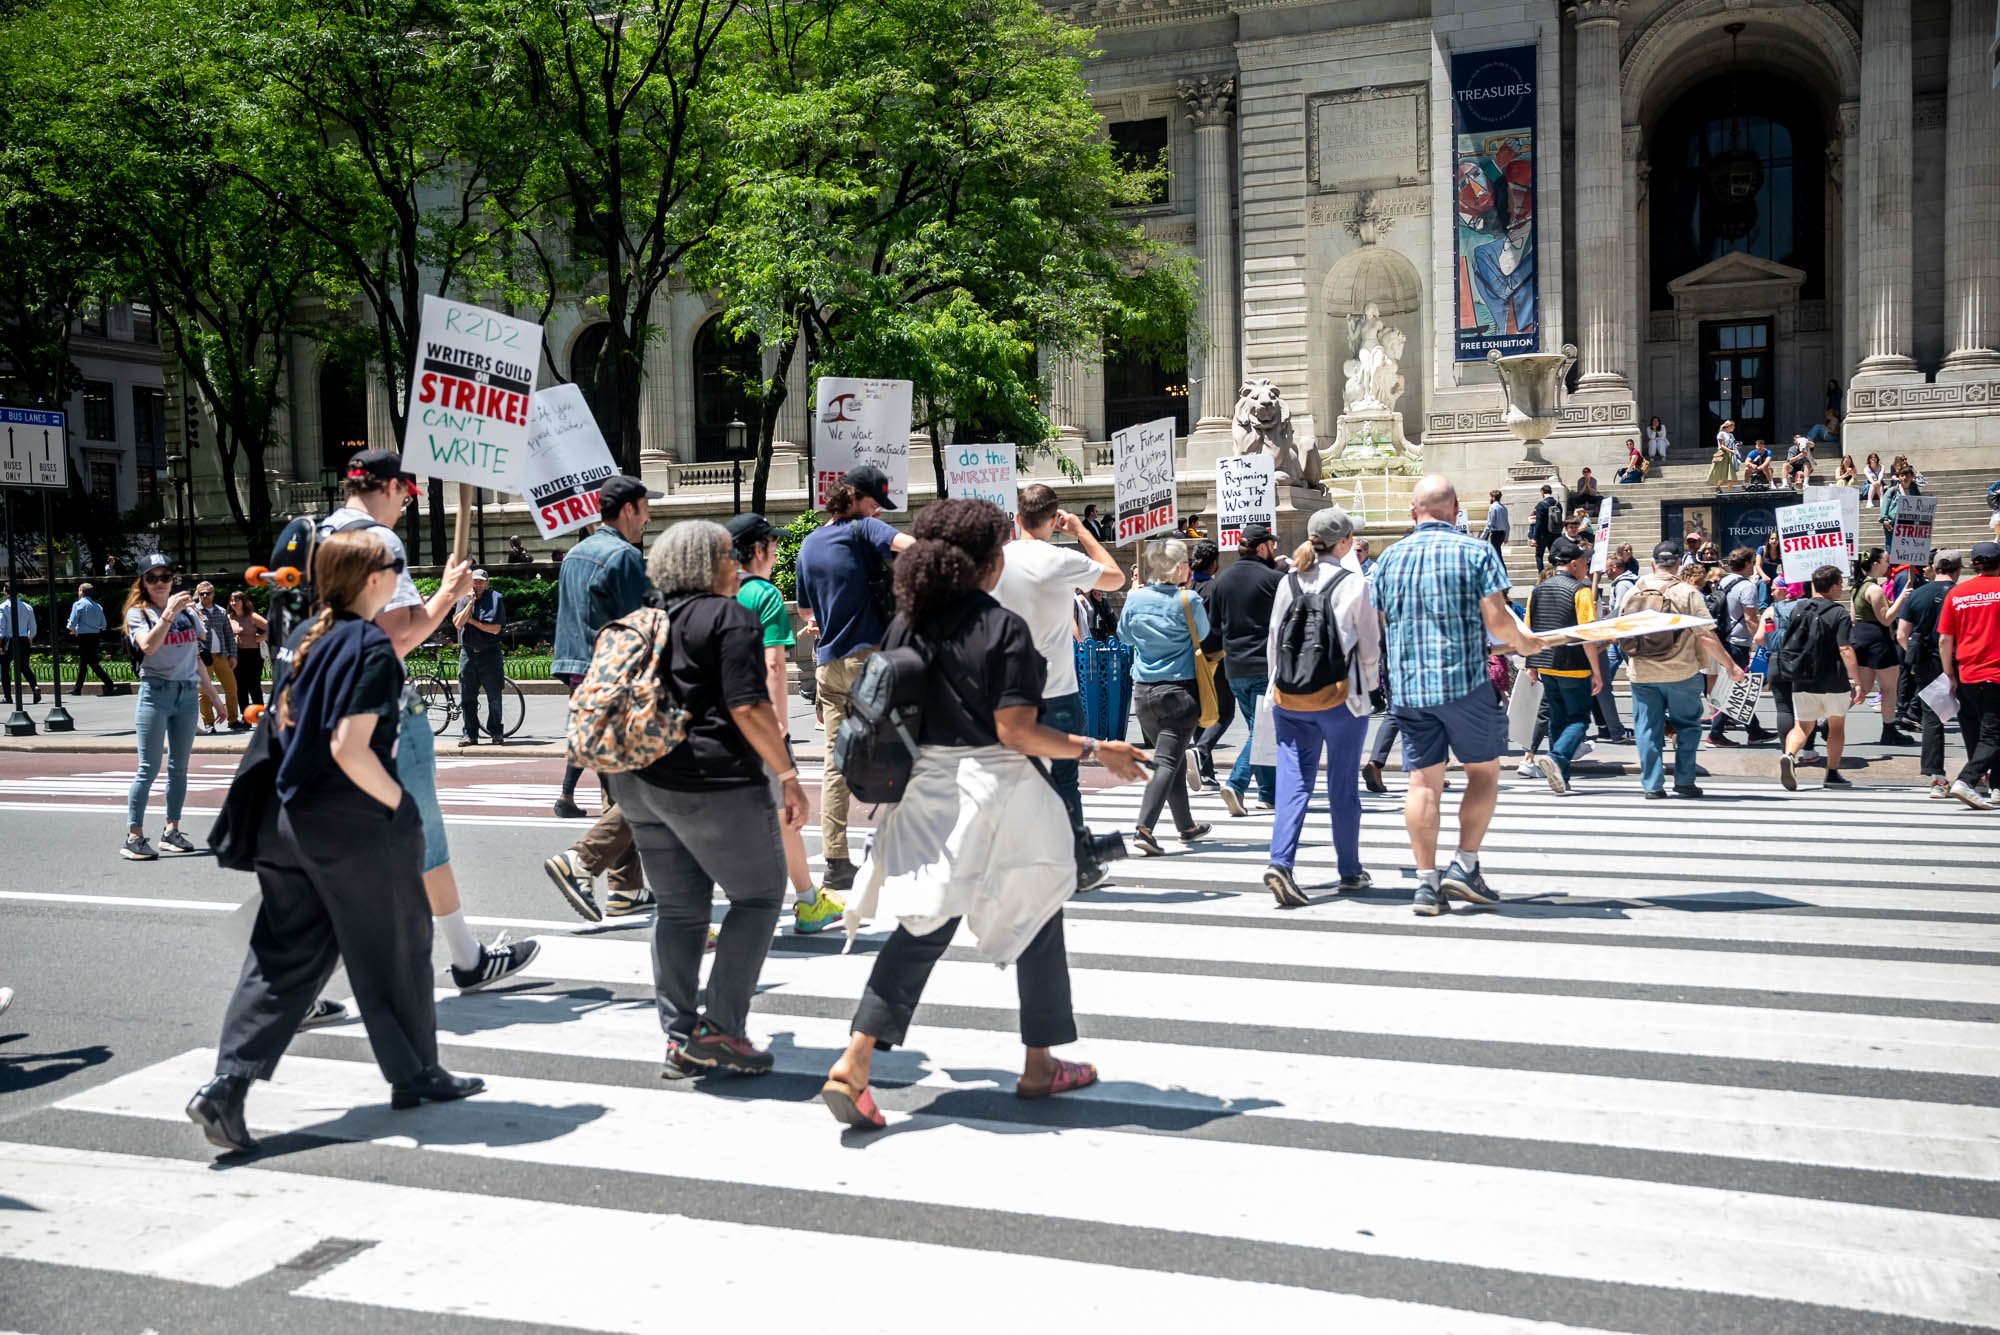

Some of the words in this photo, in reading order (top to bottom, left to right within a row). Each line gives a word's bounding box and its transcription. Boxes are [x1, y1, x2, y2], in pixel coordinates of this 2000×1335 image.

[1457, 83, 1532, 102] TREASURES
[445, 307, 521, 350] R2D2
[1460, 342, 1480, 350] FREE
[1482, 339, 1533, 349] EXHIBITION
[427, 342, 493, 372] WRITERS
[496, 359, 532, 383] GUILD
[474, 371, 490, 385] ON
[419, 372, 530, 427] STRIKE!
[8, 411, 22, 421] BUS
[25, 412, 47, 424] LANES
[423, 408, 486, 435] CAN'T
[1115, 432, 1135, 458] The
[1139, 429, 1165, 451] Future
[428, 434, 510, 474] WRITE
[959, 448, 980, 466] do
[985, 448, 1009, 465] the
[3, 461, 22, 470] BUSES
[40, 462, 57, 473] BUSES
[1120, 456, 1132, 473] of
[1233, 458, 1252, 469] The
[5, 472, 21, 481] ONLY
[41, 473, 56, 483] ONLY
[530, 472, 580, 499] WRITERS
[581, 465, 613, 483] GUILD
[950, 467, 1010, 485] WRITE
[1224, 470, 1268, 488] Beginning
[1119, 495, 1149, 512] WRITERS
[1150, 488, 1172, 501] GUILD
[1222, 489, 1242, 499] Was
[1245, 486, 1266, 496] The
[541, 490, 601, 531] STRIK
[1224, 496, 1263, 512] Word
[1119, 504, 1173, 540] STRIKE!
[1220, 514, 1247, 523] WRITERS
[1248, 513, 1271, 522] GUILD
[1781, 523, 1815, 534] WRITERS
[1816, 519, 1840, 529] GUILD
[1728, 526, 1778, 536] TREASUR
[1895, 525, 1932, 539] STRIKE!
[1783, 531, 1843, 553] STRIKE!
[1746, 675, 1761, 702] FAIR
[1739, 703, 1753, 721] PAY
